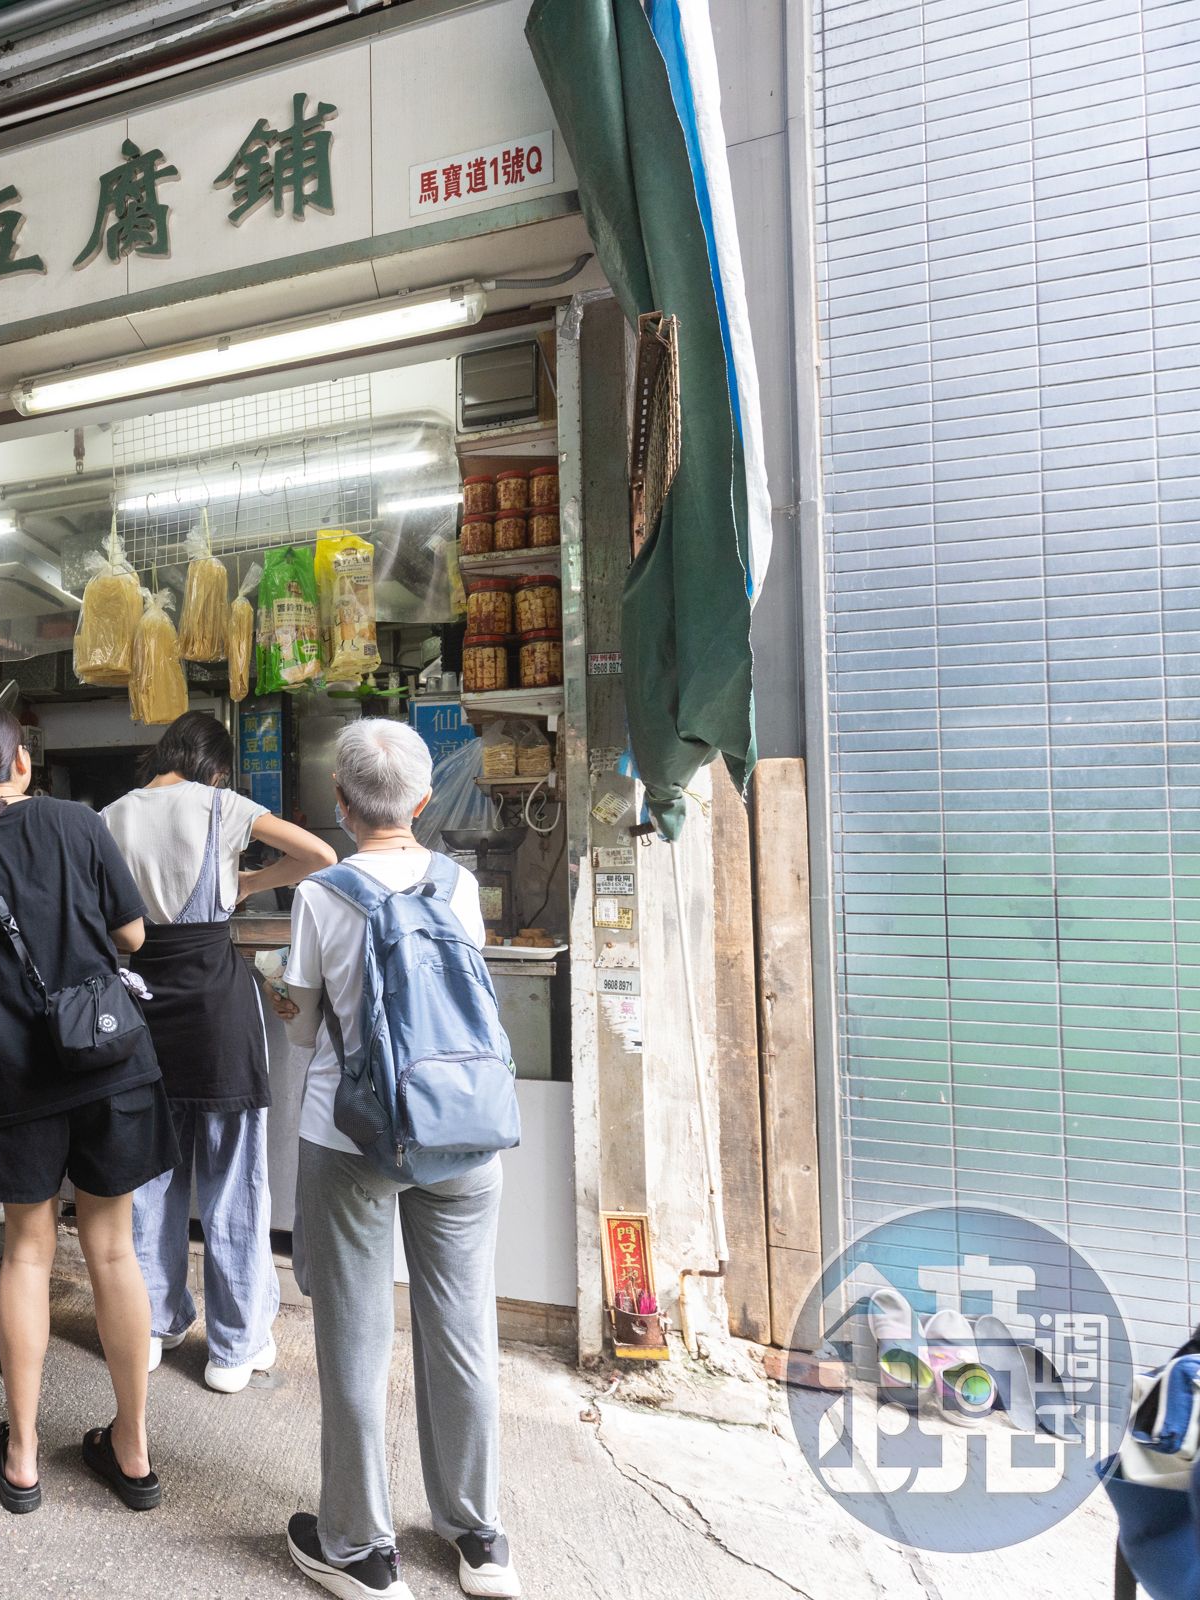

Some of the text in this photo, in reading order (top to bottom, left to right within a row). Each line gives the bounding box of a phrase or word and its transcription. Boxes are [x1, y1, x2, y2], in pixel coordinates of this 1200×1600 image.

[418, 145, 543, 205] 馬寶道1號Q
[603, 979, 633, 991] 9608 8971
[616, 1226, 642, 1288] 門口土地
